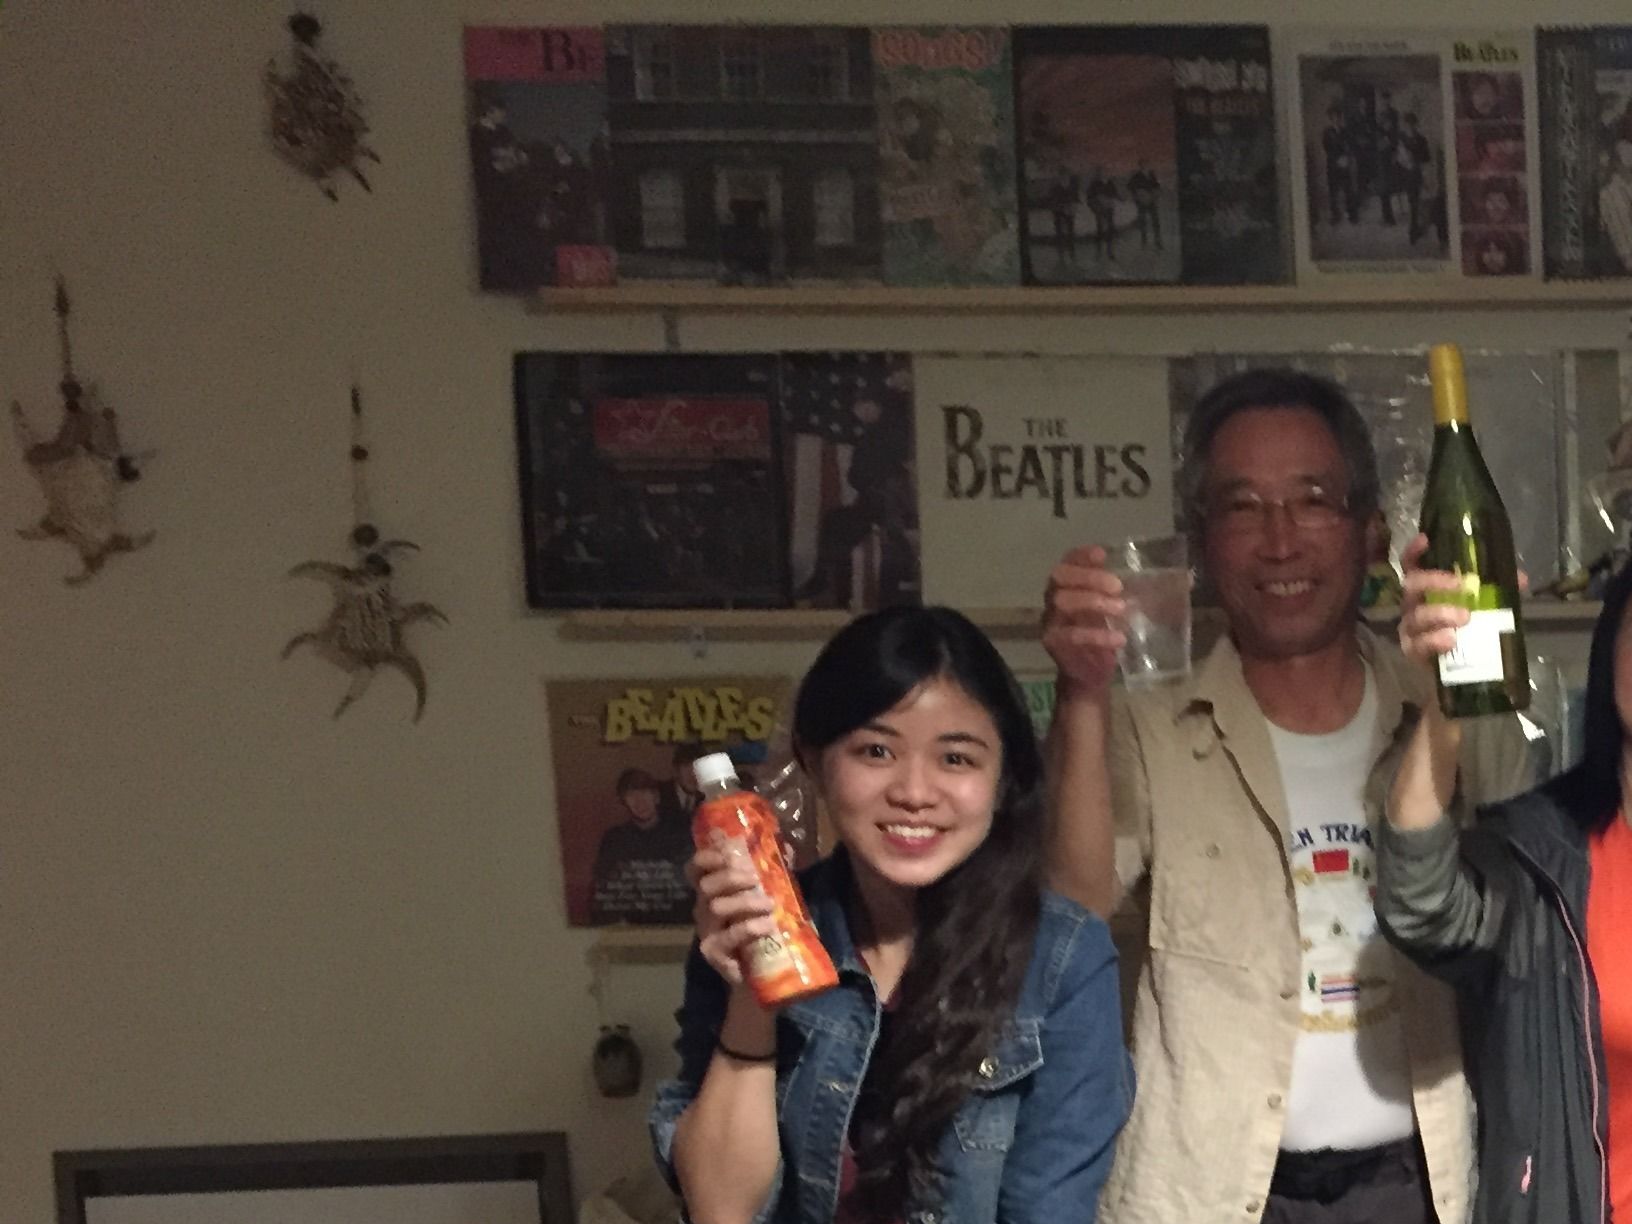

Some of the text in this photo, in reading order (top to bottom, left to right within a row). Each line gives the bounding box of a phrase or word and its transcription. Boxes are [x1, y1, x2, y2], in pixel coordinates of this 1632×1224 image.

[1022, 416, 1069, 439] THE
[940, 403, 1152, 520] BEATLES
[604, 686, 775, 743] BEATLES
